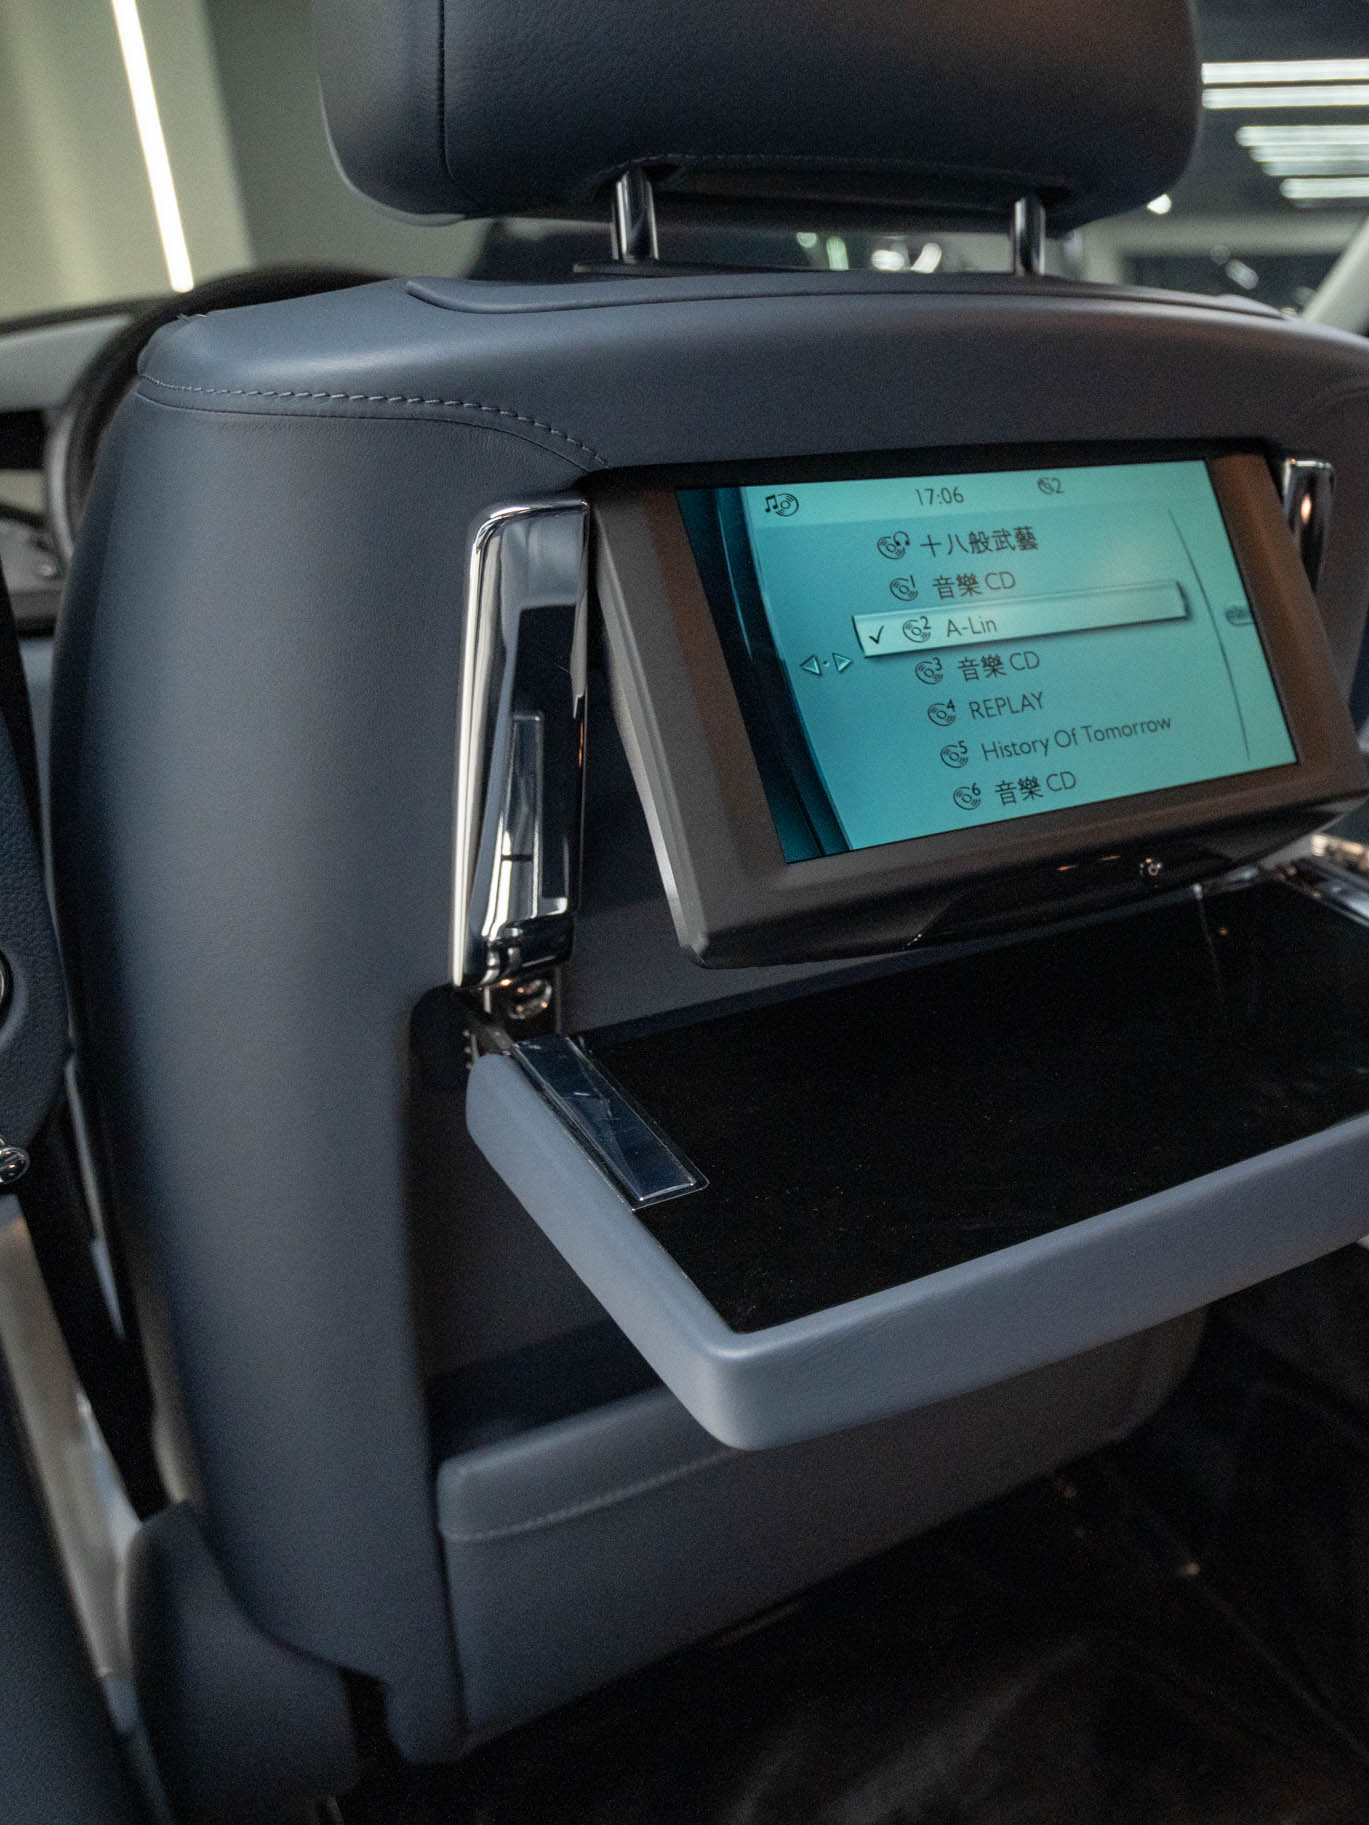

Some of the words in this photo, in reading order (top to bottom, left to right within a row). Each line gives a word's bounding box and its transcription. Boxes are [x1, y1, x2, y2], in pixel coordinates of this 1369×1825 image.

[915, 487, 965, 506] 17:06
[920, 526, 1039, 557] 十八般武藝
[946, 616, 998, 637] A-Lin
[968, 691, 1044, 720] REPLAY
[981, 737, 1049, 761] History
[1054, 727, 1079, 748] Of
[1080, 717, 1172, 744] Tomorrow
